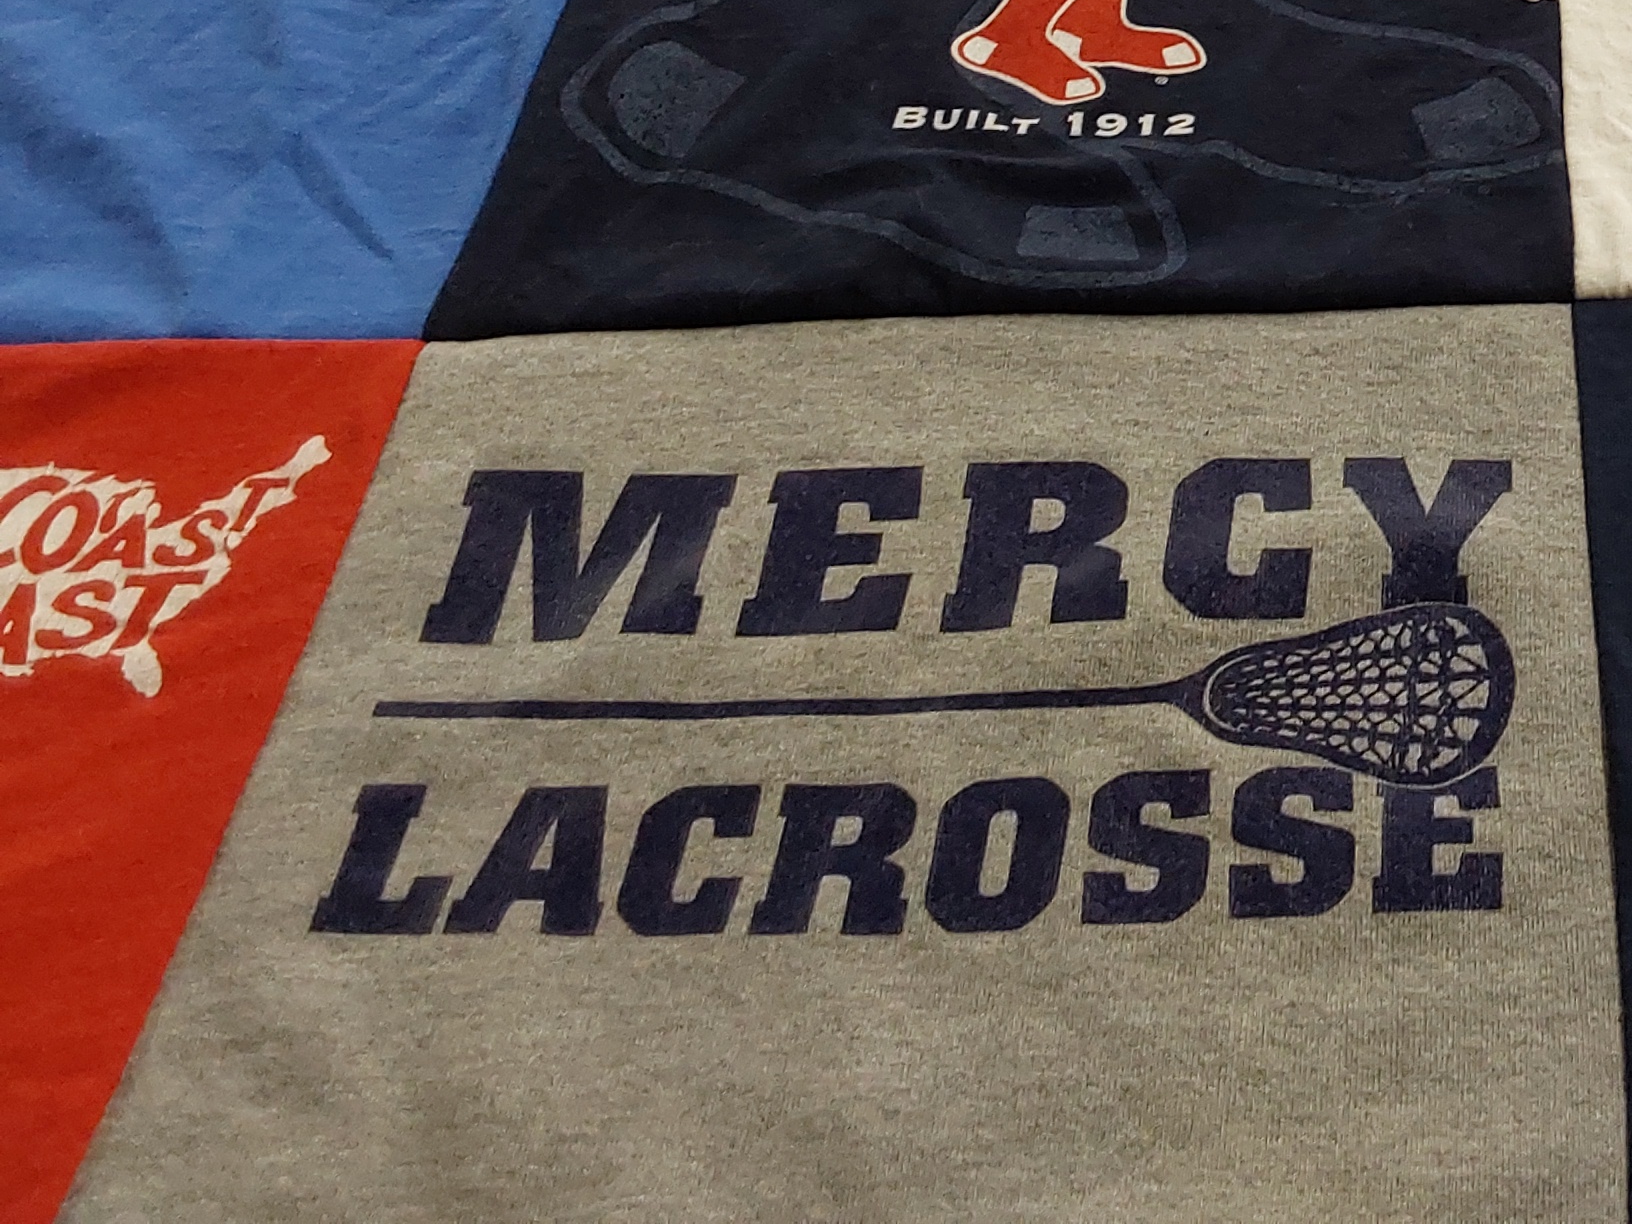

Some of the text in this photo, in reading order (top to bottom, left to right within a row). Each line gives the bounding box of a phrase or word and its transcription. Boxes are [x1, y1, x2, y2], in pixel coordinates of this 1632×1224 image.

[893, 106, 1198, 137] BUILT 1912
[420, 457, 1513, 644] MERCY
[310, 768, 1503, 937] LACROSSE
